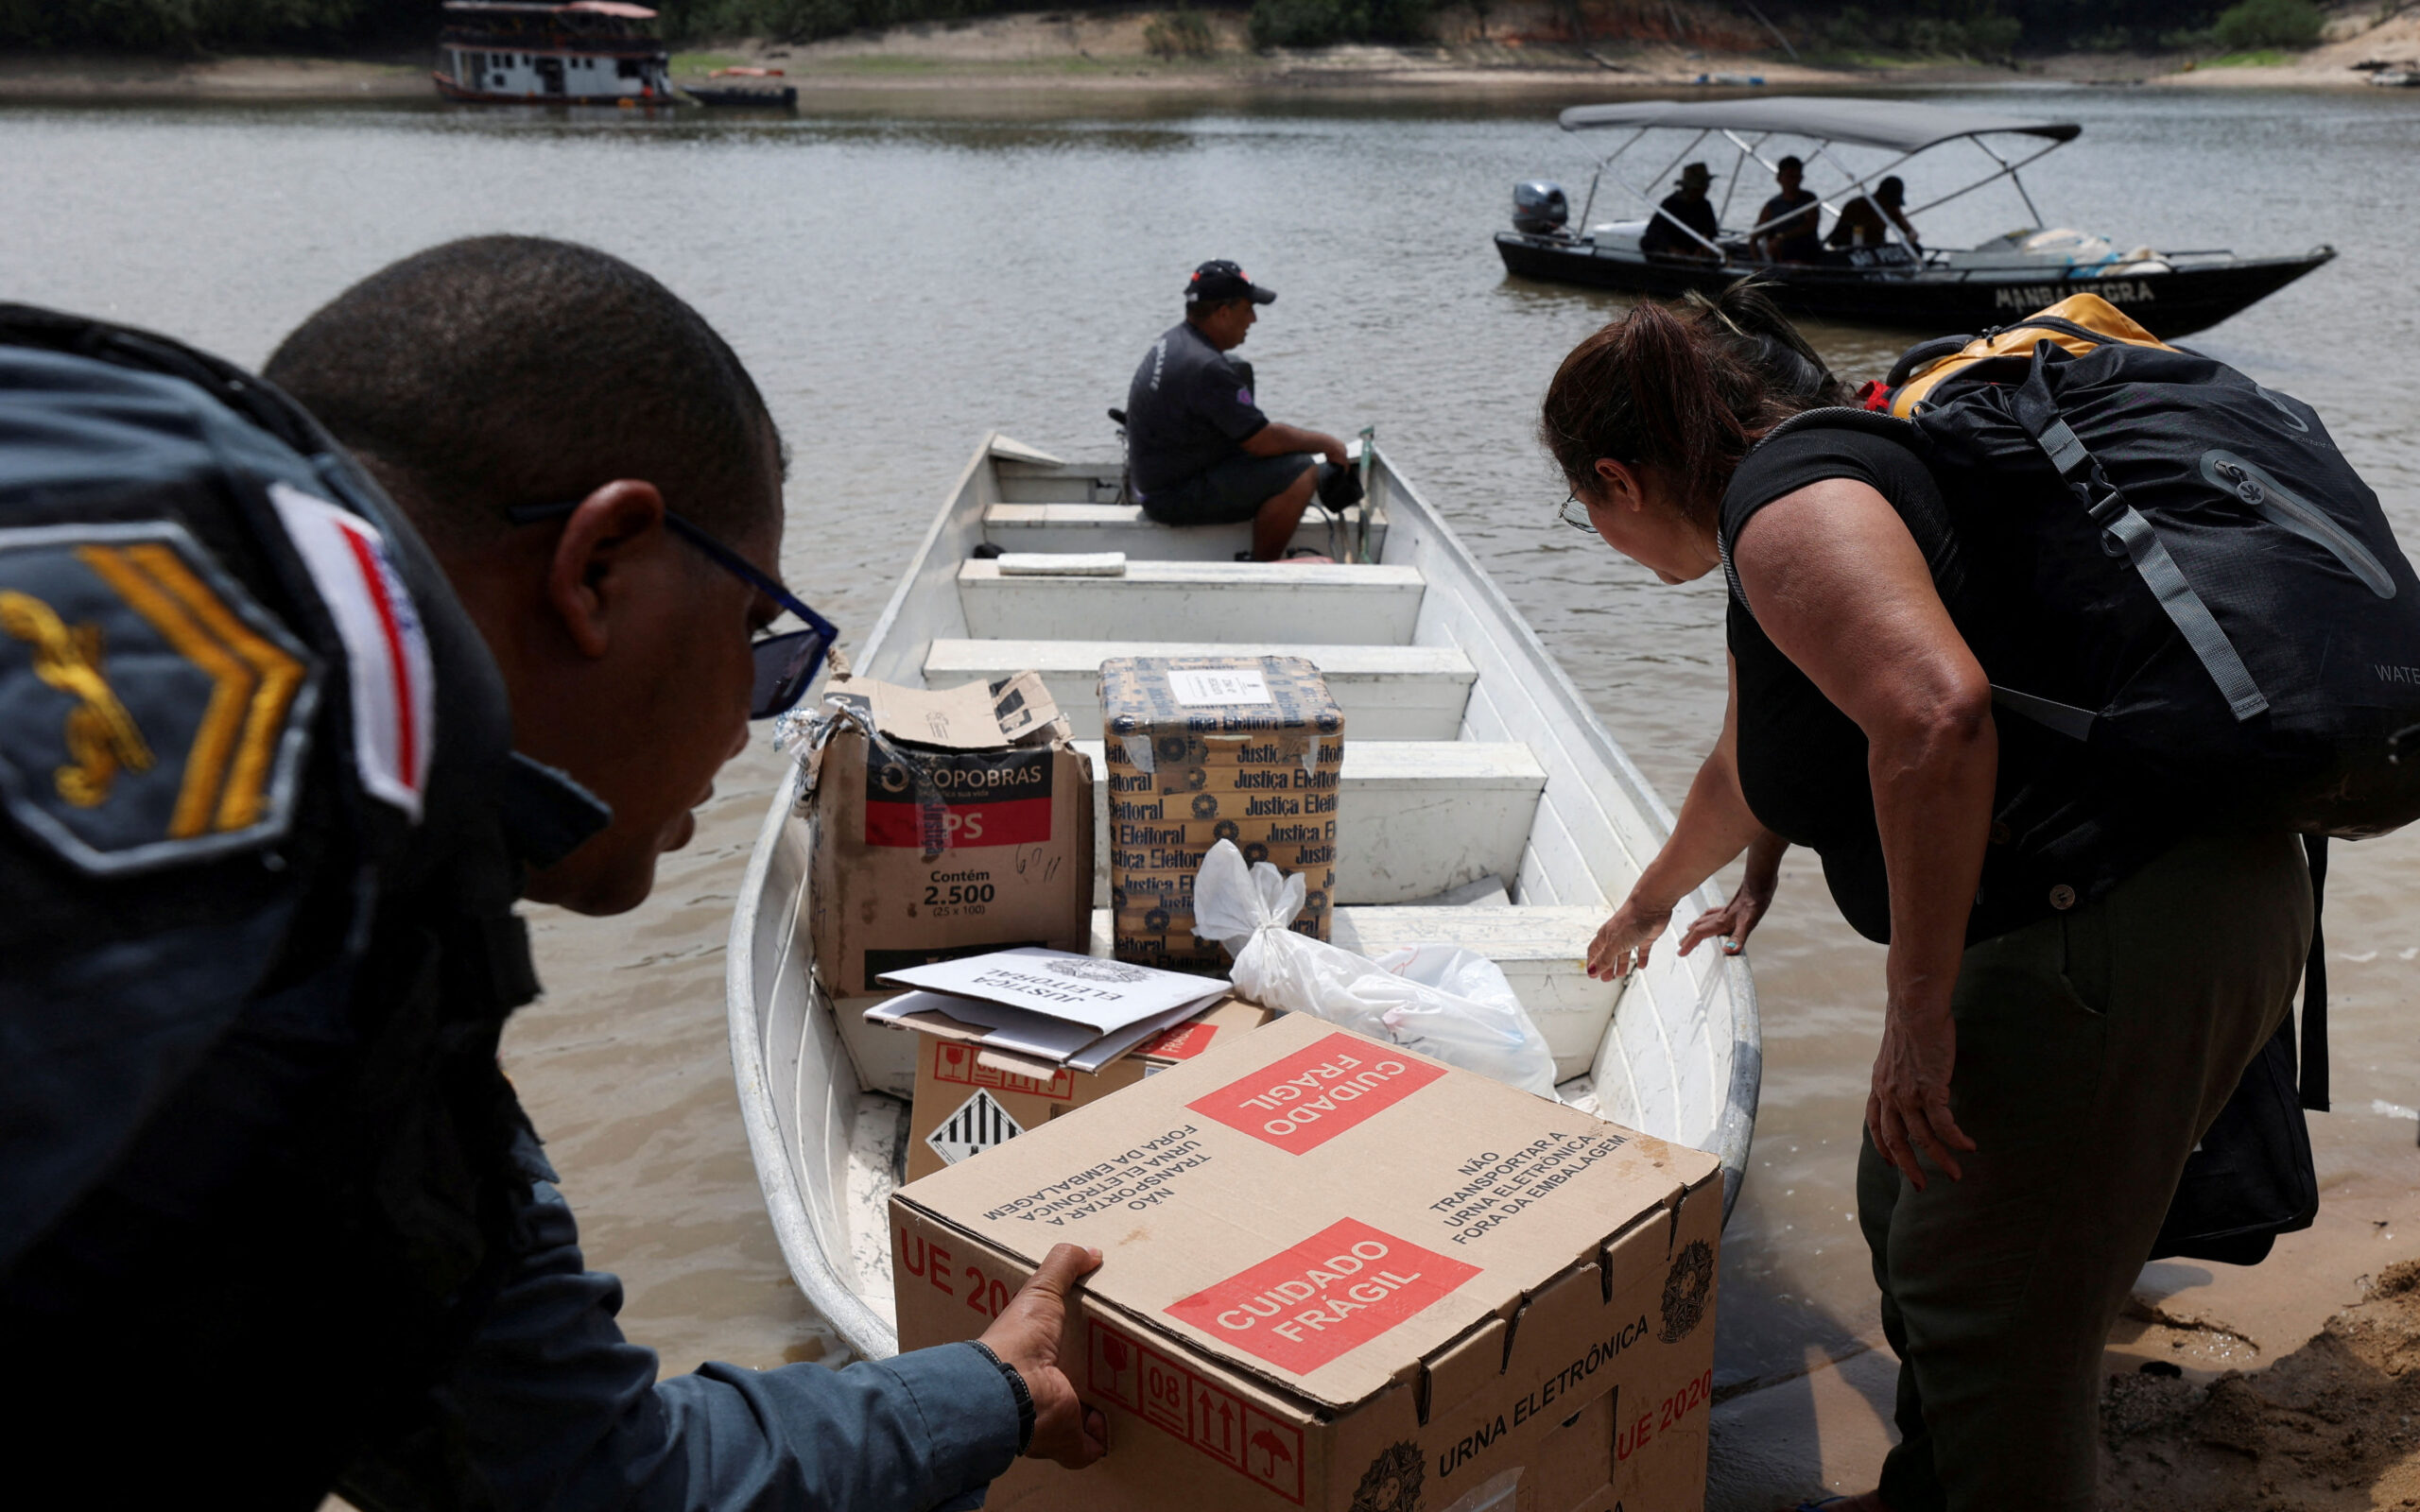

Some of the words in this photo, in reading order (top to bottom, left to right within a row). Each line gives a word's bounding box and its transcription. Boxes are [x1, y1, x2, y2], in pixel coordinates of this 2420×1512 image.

[1236, 744, 1278, 765] Justiç
[1235, 769, 1288, 790] Justiça
[1294, 768, 1340, 789] Eleitor
[1245, 796, 1299, 816] Justiça
[1305, 794, 1339, 814] Eleit
[1120, 824, 1185, 845] Eleitoral
[1150, 850, 1206, 868] Eleitor
[930, 870, 990, 883] Contém
[924, 884, 994, 905] 2.500
[963, 904, 985, 916] 100)
[985, 968, 1124, 1002] ELEITORAL
[1238, 1054, 1362, 1110] FRÁGIL
[1264, 1060, 1406, 1136] CUIDADO
[1141, 1125, 1198, 1151] FORA
[1144, 1140, 1201, 1167] URNA
[1112, 1149, 1146, 1165] DA
[1429, 1139, 1555, 1212] TRANSPORTAR
[1548, 1131, 1569, 1143] A
[1458, 1152, 1500, 1177] NÃO
[983, 1163, 1115, 1221] EMBALAGEM
[1017, 1165, 1146, 1221] ELETRÔNICA
[1064, 1154, 1212, 1220] TRANSPORTAR
[1443, 1196, 1500, 1228] URNA
[1492, 1134, 1597, 1198] ELETRÔNICA
[1128, 1187, 1175, 1211] NÃO
[1046, 1216, 1065, 1227] A
[1452, 1212, 1509, 1246] FORA
[1500, 1197, 1533, 1215] DA
[901, 1227, 954, 1297] UE
[966, 1266, 1019, 1319] 20
[1216, 1241, 1390, 1331] CUIDADO
[1271, 1270, 1422, 1343] FRÁGIL
[1150, 1366, 1181, 1410] 08
[1439, 1414, 1508, 1479] URNA
[1513, 1314, 1650, 1428] ELETRÔNICA
[1617, 1412, 1653, 1462] UE
[1659, 1367, 1712, 1433] 2020
